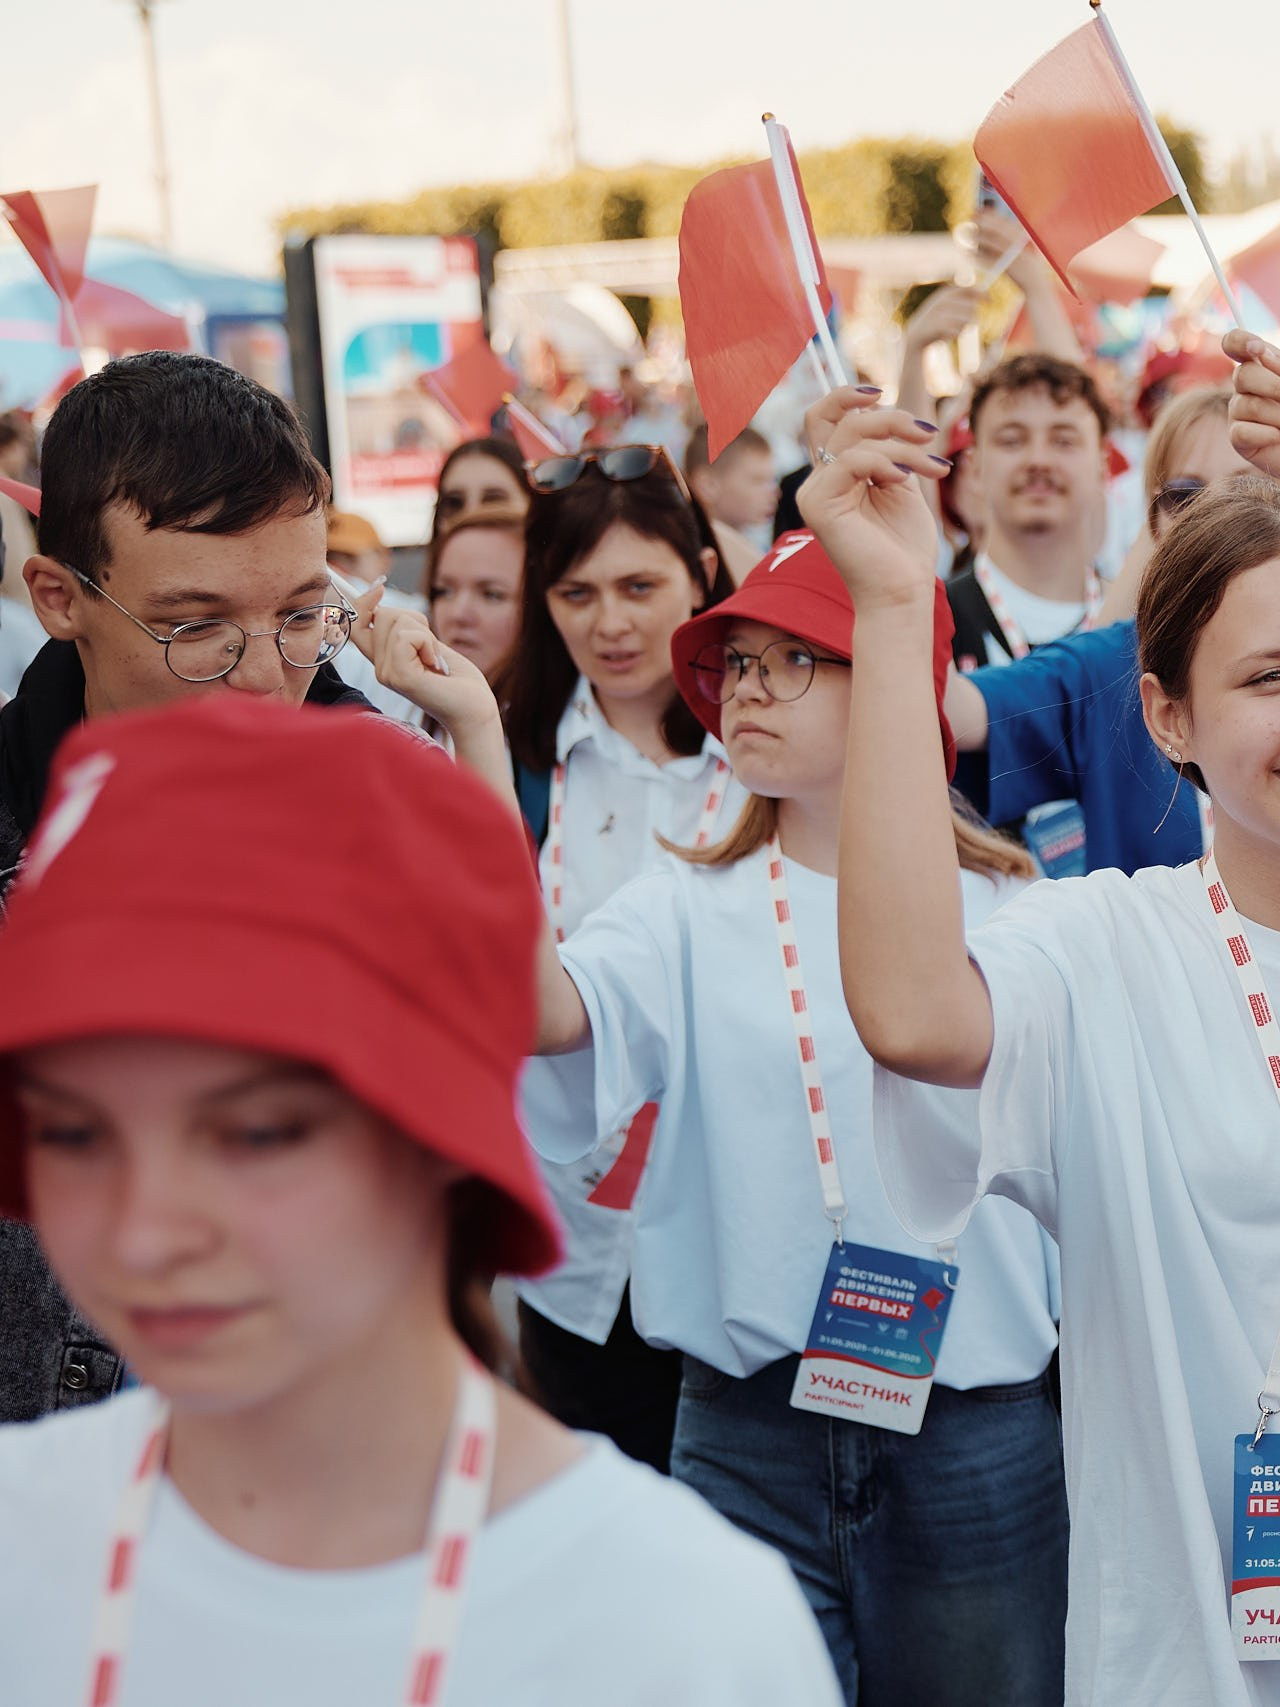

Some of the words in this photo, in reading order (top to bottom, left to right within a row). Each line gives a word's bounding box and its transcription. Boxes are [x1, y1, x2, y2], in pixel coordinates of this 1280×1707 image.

[836, 1278, 915, 1302] ДВИЖЕНИЯ
[840, 1266, 917, 1290] ФЕСТИВАЛЬ
[832, 1290, 912, 1318] ПЕРВЫХ
[804, 1392, 864, 1410] PARTICIPANT
[810, 1372, 912, 1406] УЧАСТНИК
